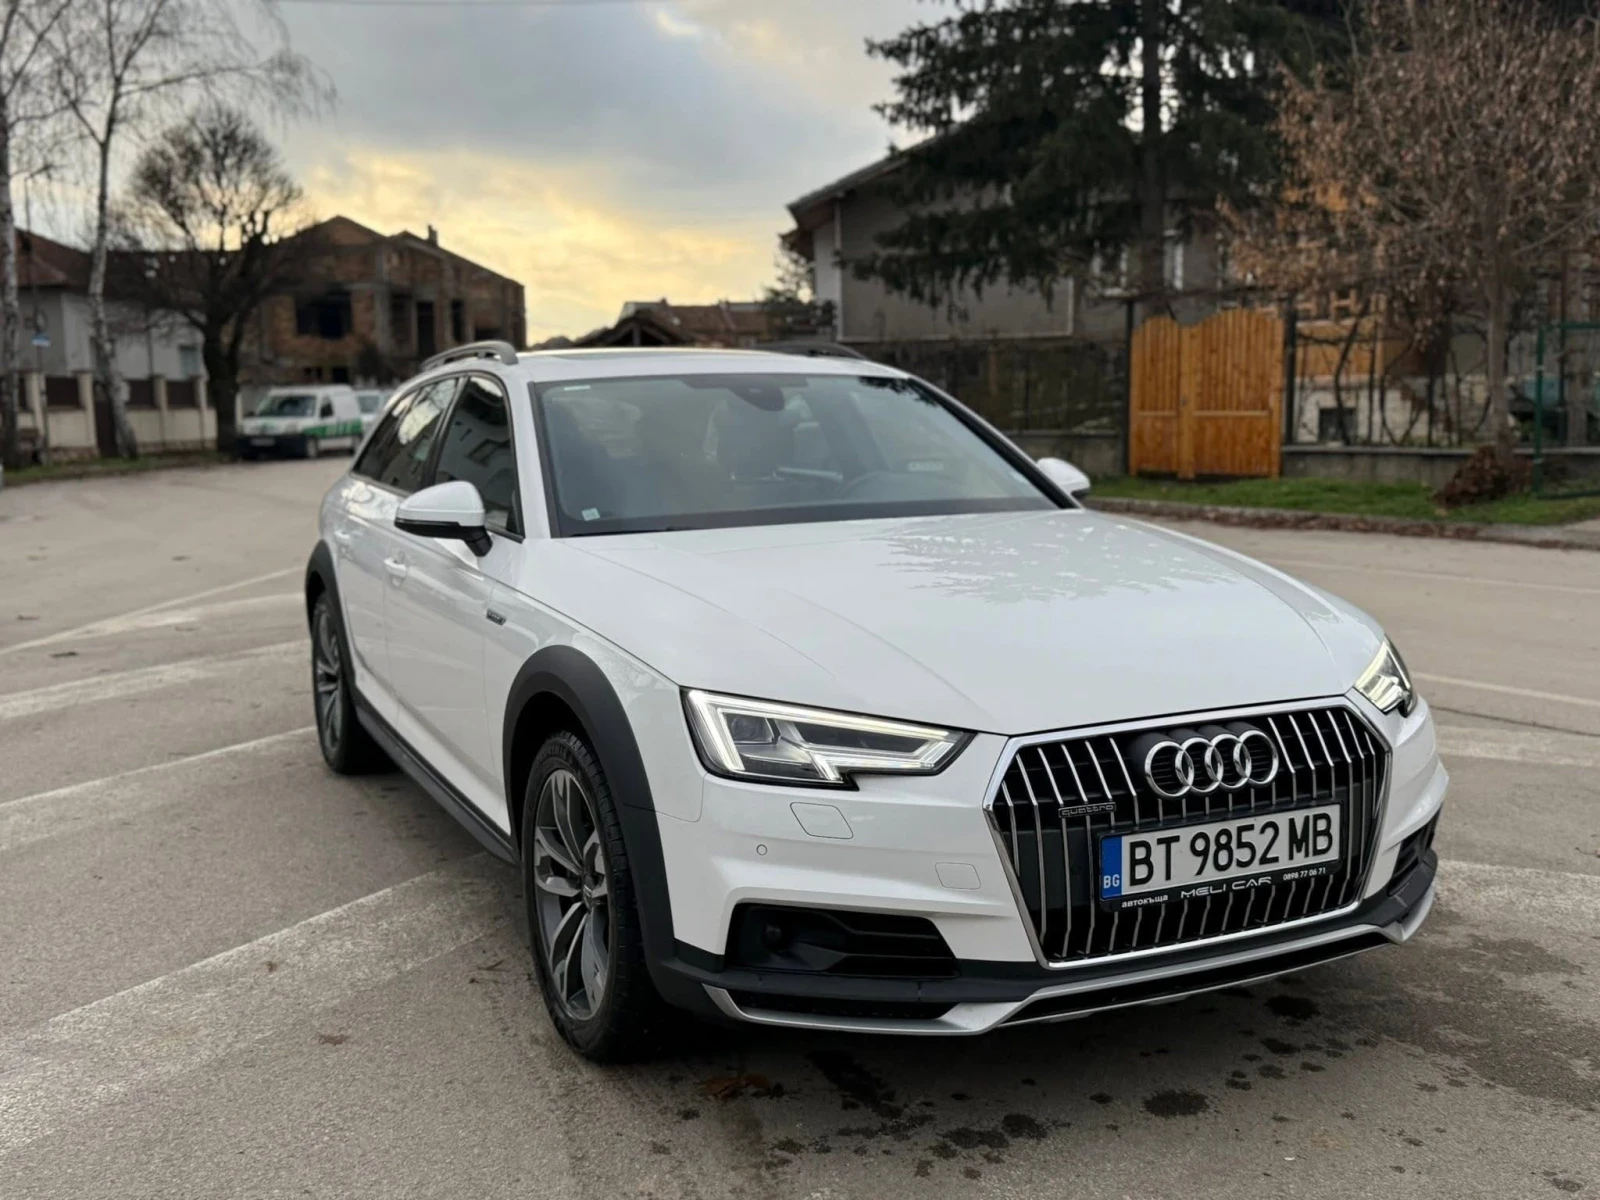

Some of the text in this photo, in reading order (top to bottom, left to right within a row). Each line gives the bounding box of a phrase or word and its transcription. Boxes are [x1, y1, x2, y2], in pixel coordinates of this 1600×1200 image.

[1061, 804, 1114, 816] quattro
[1129, 812, 1333, 887] BT 9852 MB
[1300, 870, 1308, 878] 77
[1308, 868, 1318, 877] 06
[1318, 866, 1326, 875] 71
[1103, 874, 1120, 889] BG
[1180, 876, 1272, 899] MELI CAR
[1121, 894, 1169, 908] автокъща
